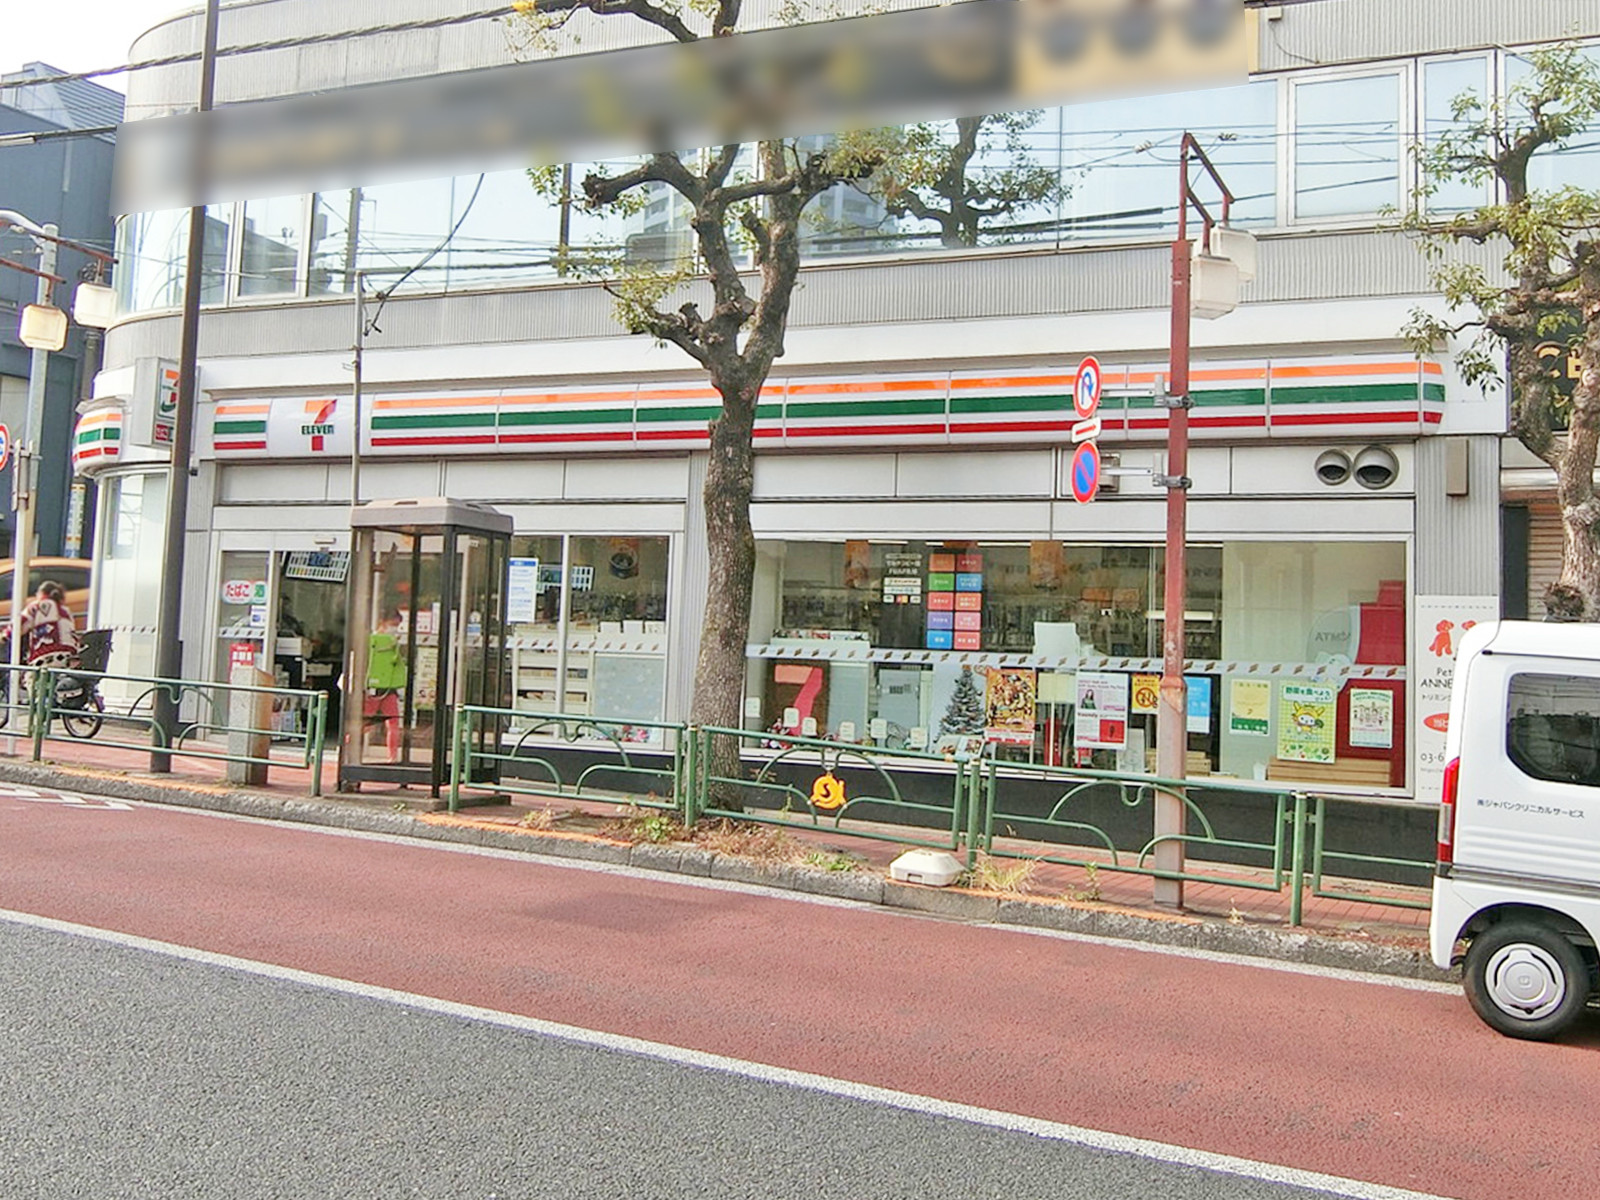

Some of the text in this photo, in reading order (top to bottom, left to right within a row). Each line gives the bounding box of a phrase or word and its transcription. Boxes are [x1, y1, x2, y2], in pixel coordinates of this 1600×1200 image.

[226, 584, 250, 597] たばこ
[1437, 667, 1452, 677] Pet
